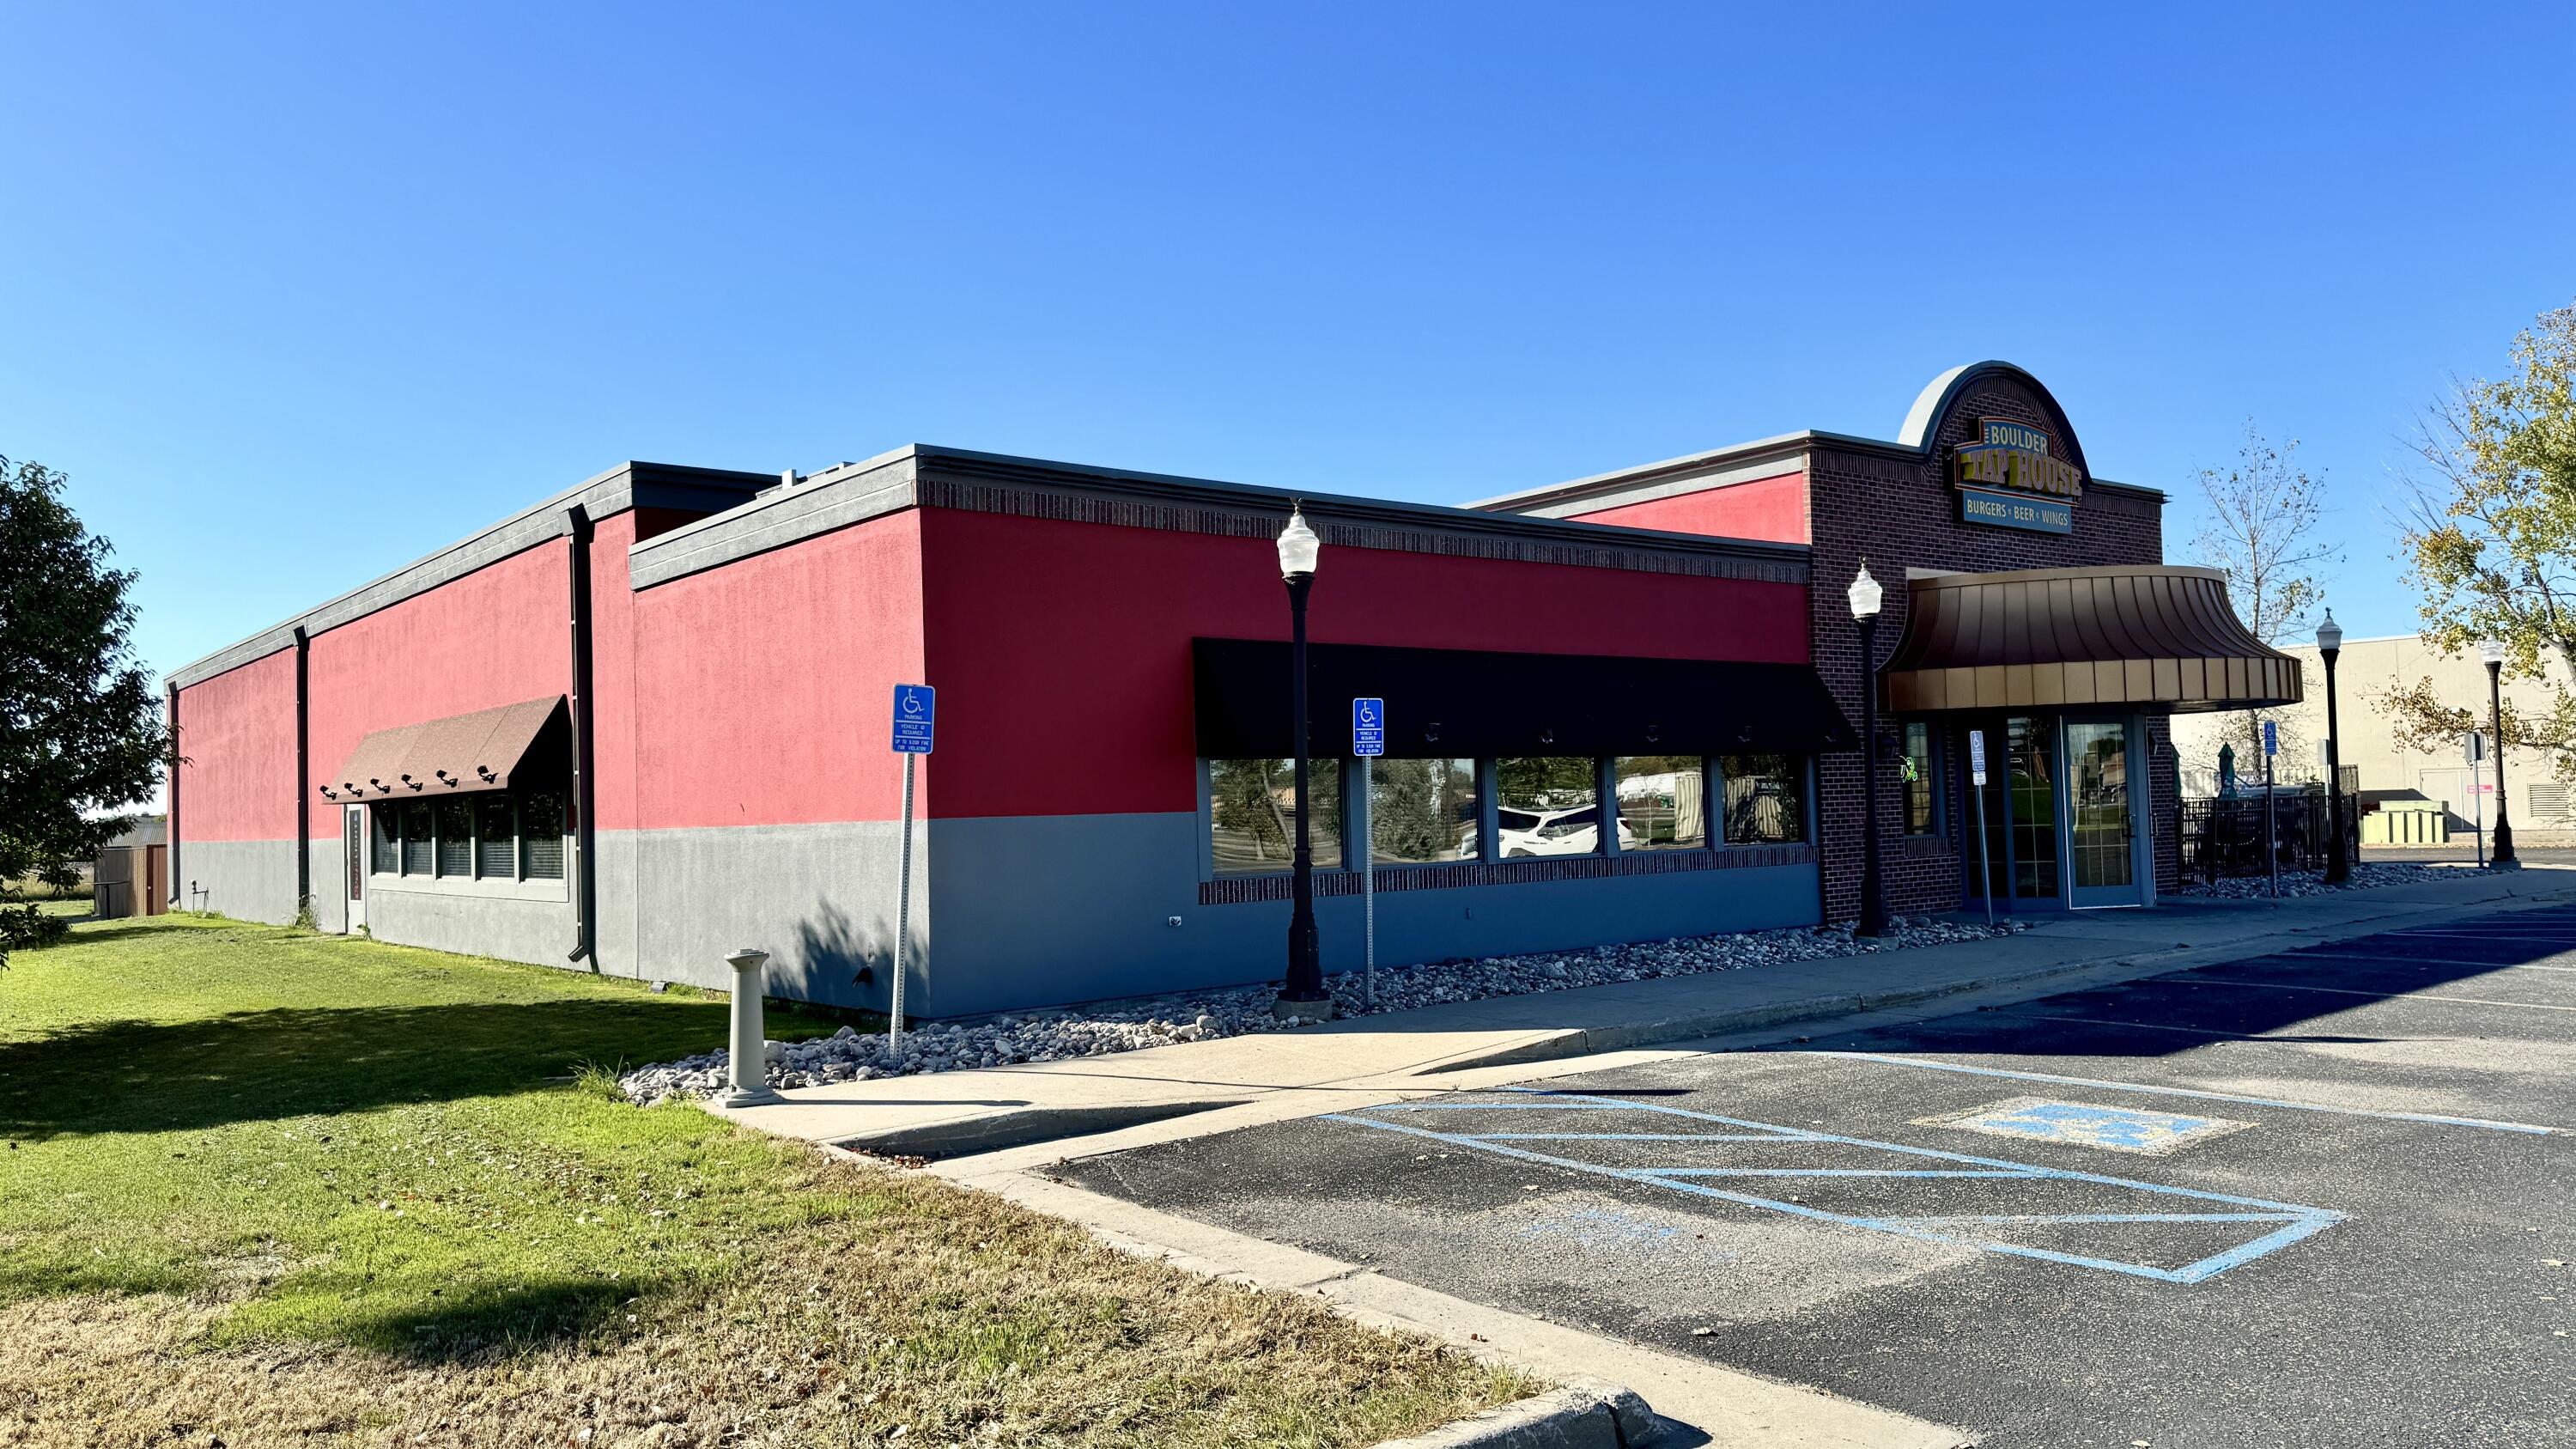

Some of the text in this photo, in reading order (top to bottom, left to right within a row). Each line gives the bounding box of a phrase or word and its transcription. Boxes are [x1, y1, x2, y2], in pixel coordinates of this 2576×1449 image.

[1991, 425, 2048, 455] BOULDER
[1964, 448, 2083, 496] TAP HOUSE
[1966, 498, 2069, 527] BURGERS BEER WINGS
